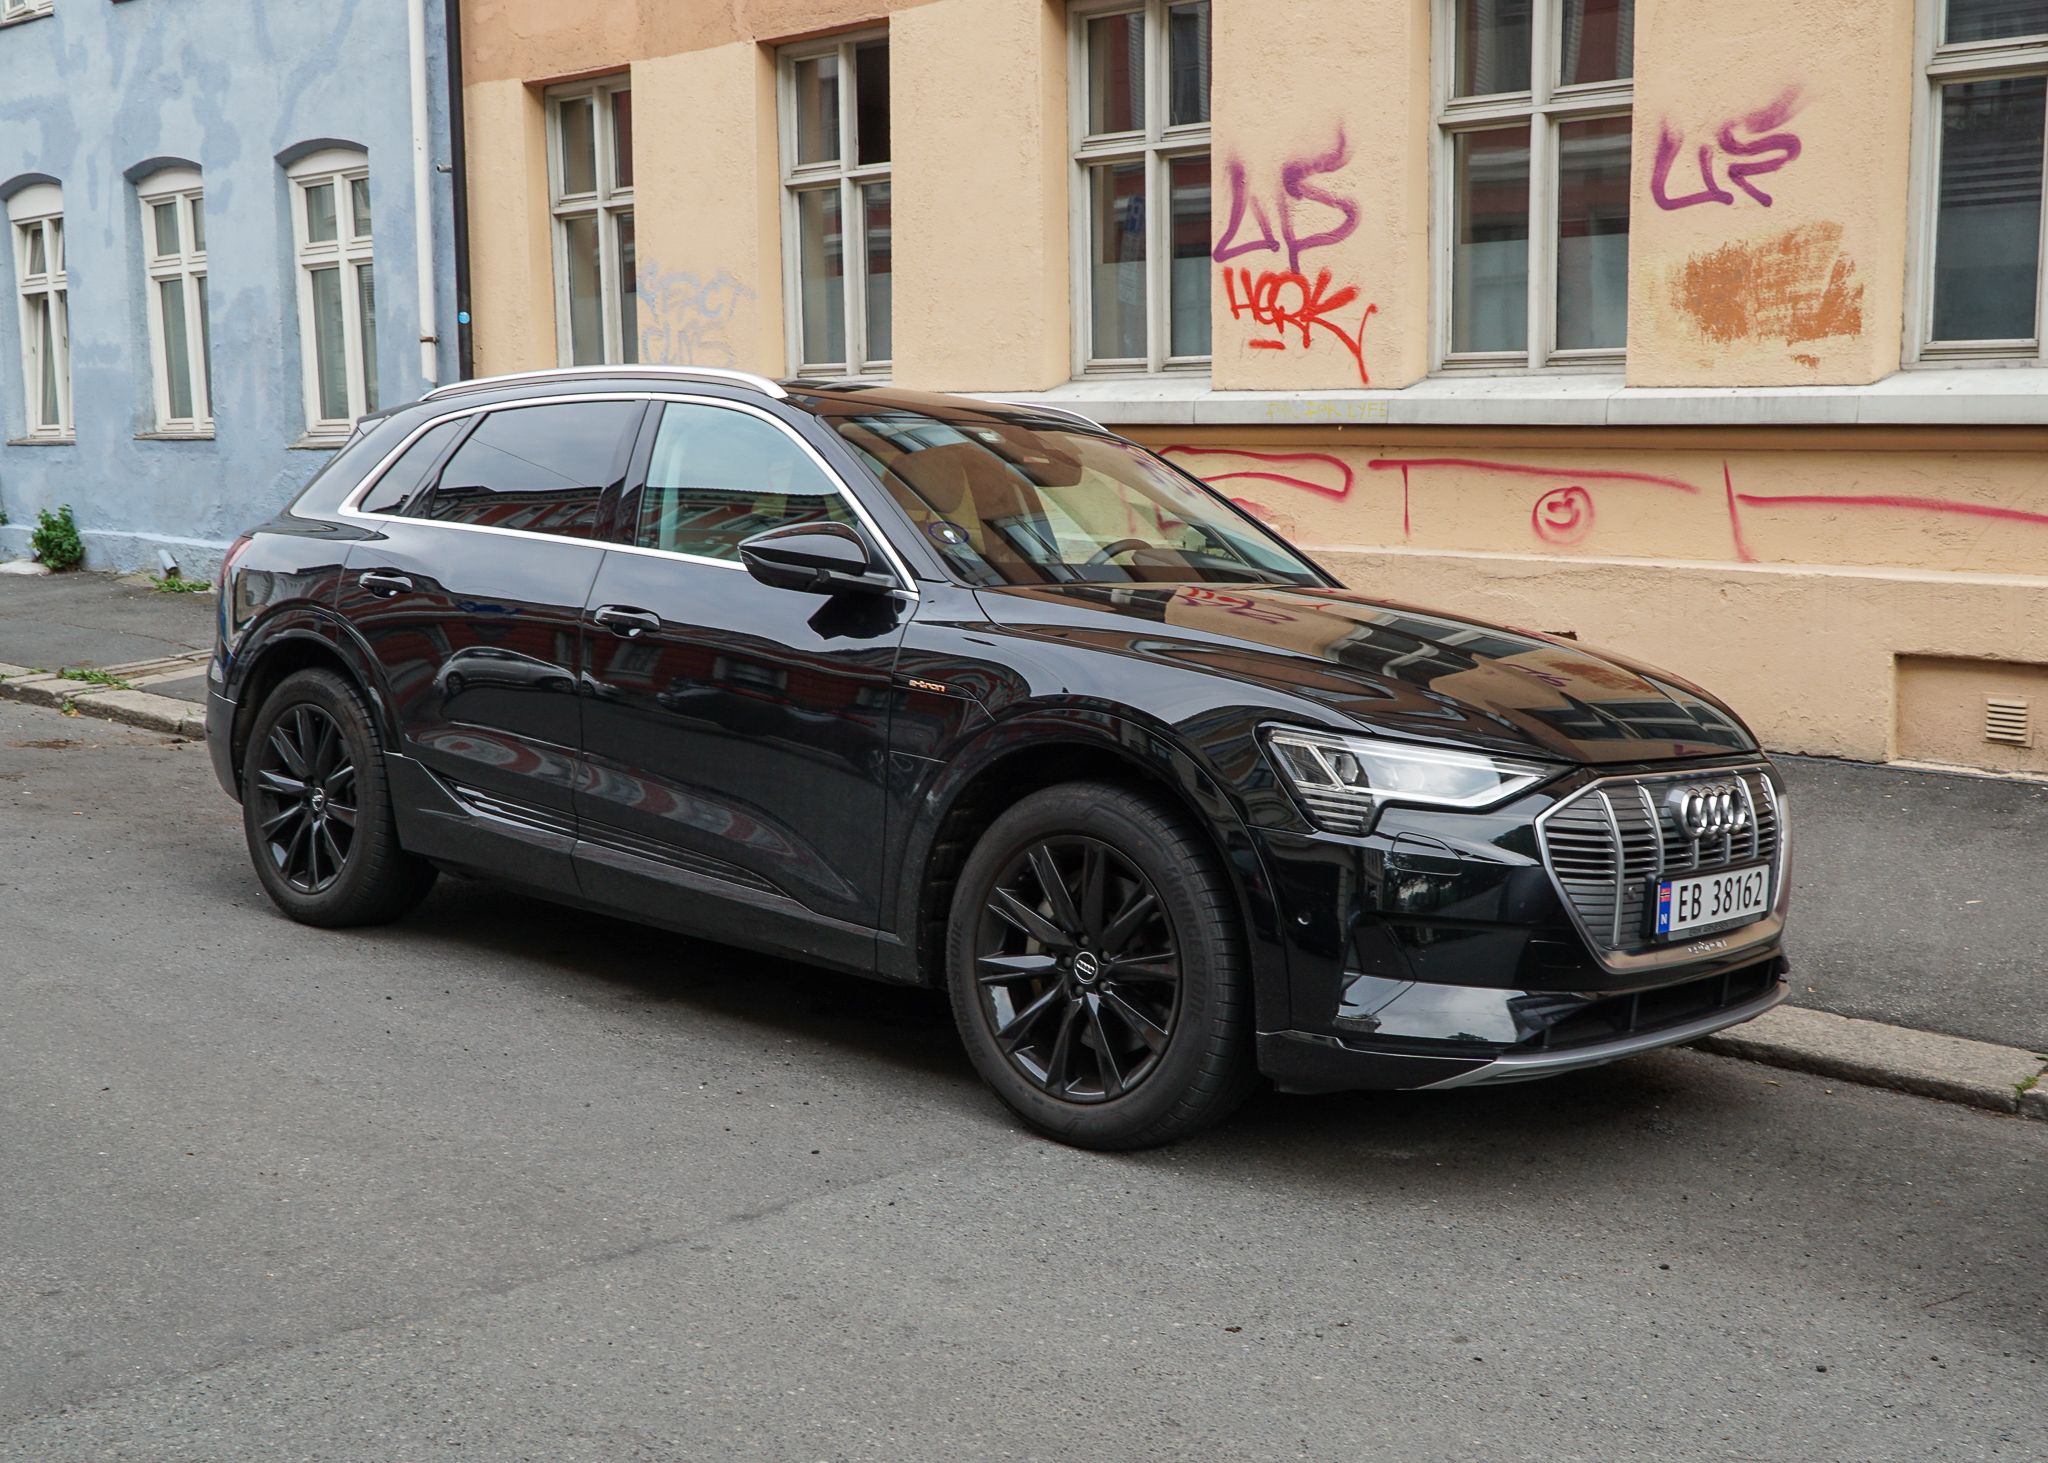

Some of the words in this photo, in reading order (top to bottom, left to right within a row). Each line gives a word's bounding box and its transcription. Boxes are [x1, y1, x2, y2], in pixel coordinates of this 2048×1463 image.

[1678, 883, 1702, 923] EB
[1711, 871, 1762, 916] 38162
[1660, 913, 1668, 925] N
